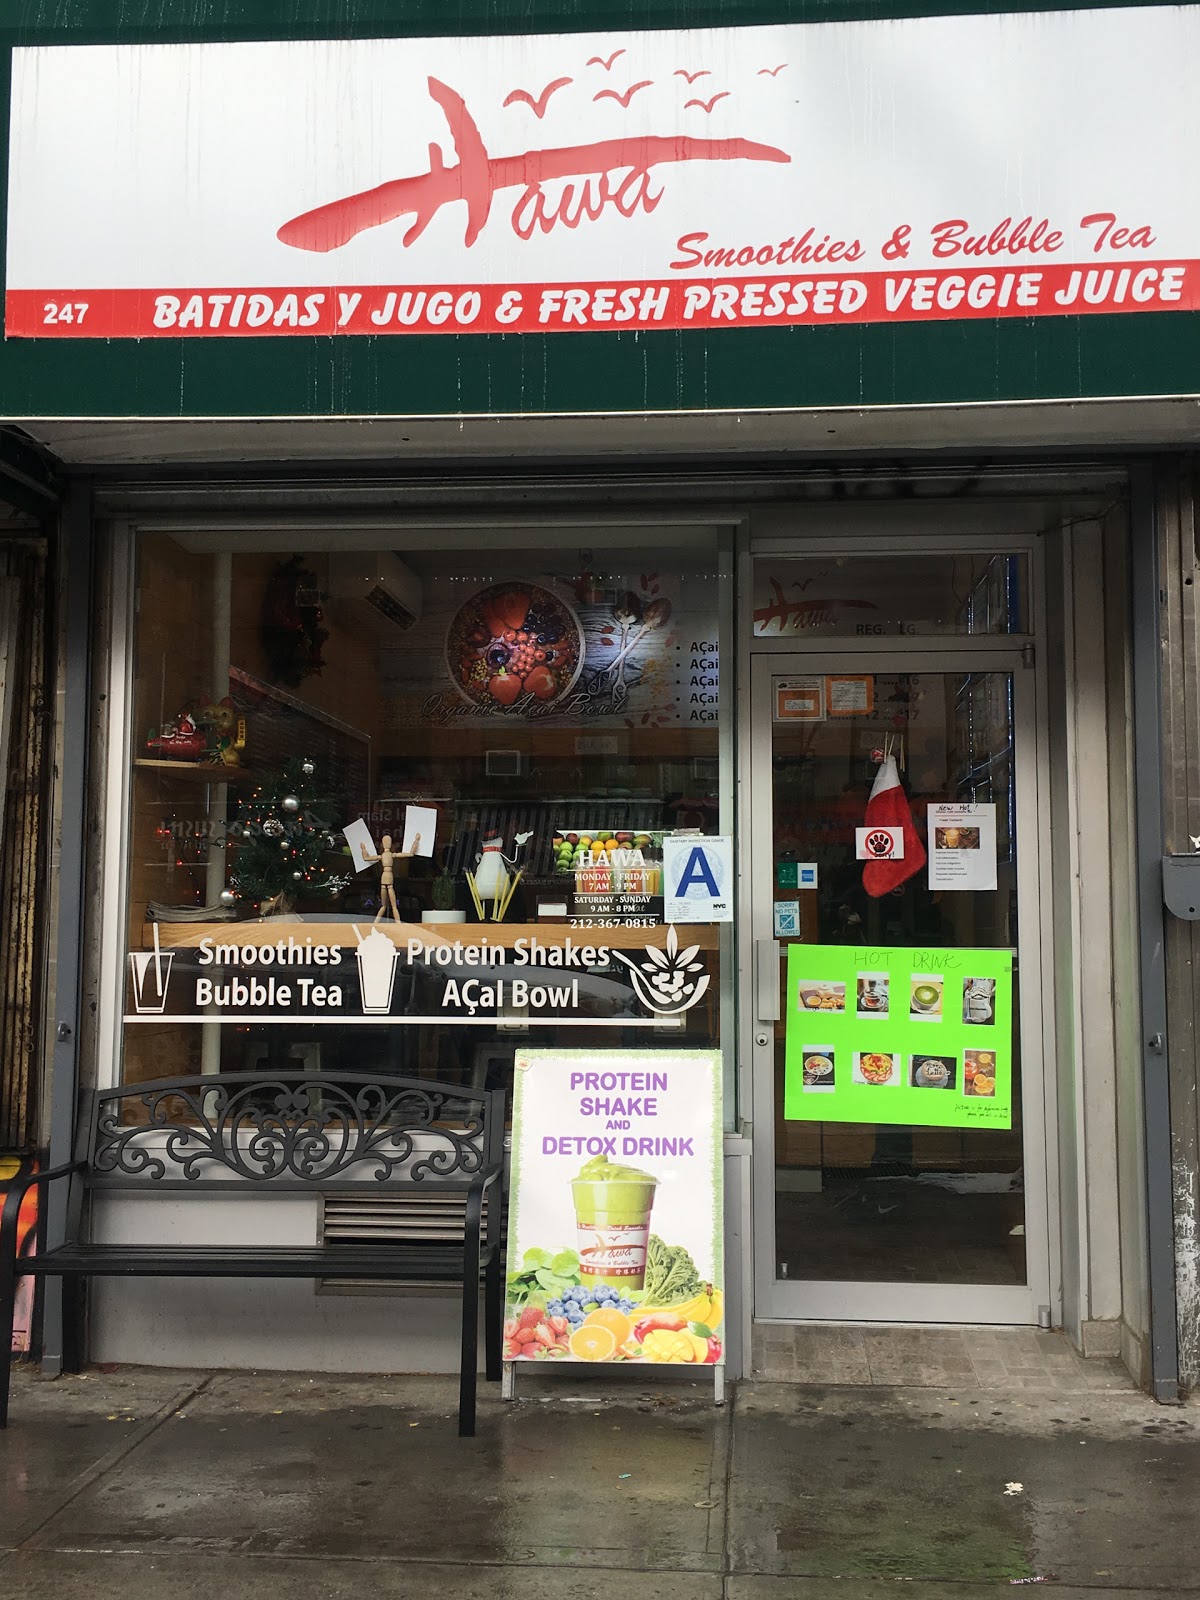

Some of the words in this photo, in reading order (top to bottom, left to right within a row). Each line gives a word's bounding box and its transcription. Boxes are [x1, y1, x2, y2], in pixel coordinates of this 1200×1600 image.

[277, 76, 791, 253] Hawa
[669, 227, 865, 270] Smoothies
[882, 224, 911, 260] &
[930, 216, 1064, 258] Bubble
[1080, 212, 1157, 250] Tea
[154, 293, 325, 328] BATIDAS
[372, 291, 481, 325] JUGO
[494, 291, 523, 323] &
[538, 286, 667, 324] FRESH
[683, 280, 868, 320] PRESSED
[885, 273, 1041, 312] VEGGIE
[1055, 266, 1186, 305] JUICE
[43, 303, 89, 325] 247
[856, 624, 886, 635] REG.
[578, 850, 646, 867] HAWA
[675, 847, 720, 897] A
[570, 919, 656, 929] 212-367-0815
[199, 937, 342, 965] Smoothies
[407, 937, 505, 966] Protein
[514, 937, 610, 966] Shakes
[854, 951, 893, 966] HOT
[913, 952, 962, 971] DRINK
[196, 977, 292, 1006] Bubble
[297, 978, 342, 1006] Tea
[512, 979, 578, 1007] Bowl
[570, 1072, 668, 1091] PROTEIN
[580, 1097, 657, 1116] SHAKE
[606, 1120, 630, 1130] AND
[542, 1136, 616, 1156] DETOX
[622, 1137, 694, 1156] DRINK
